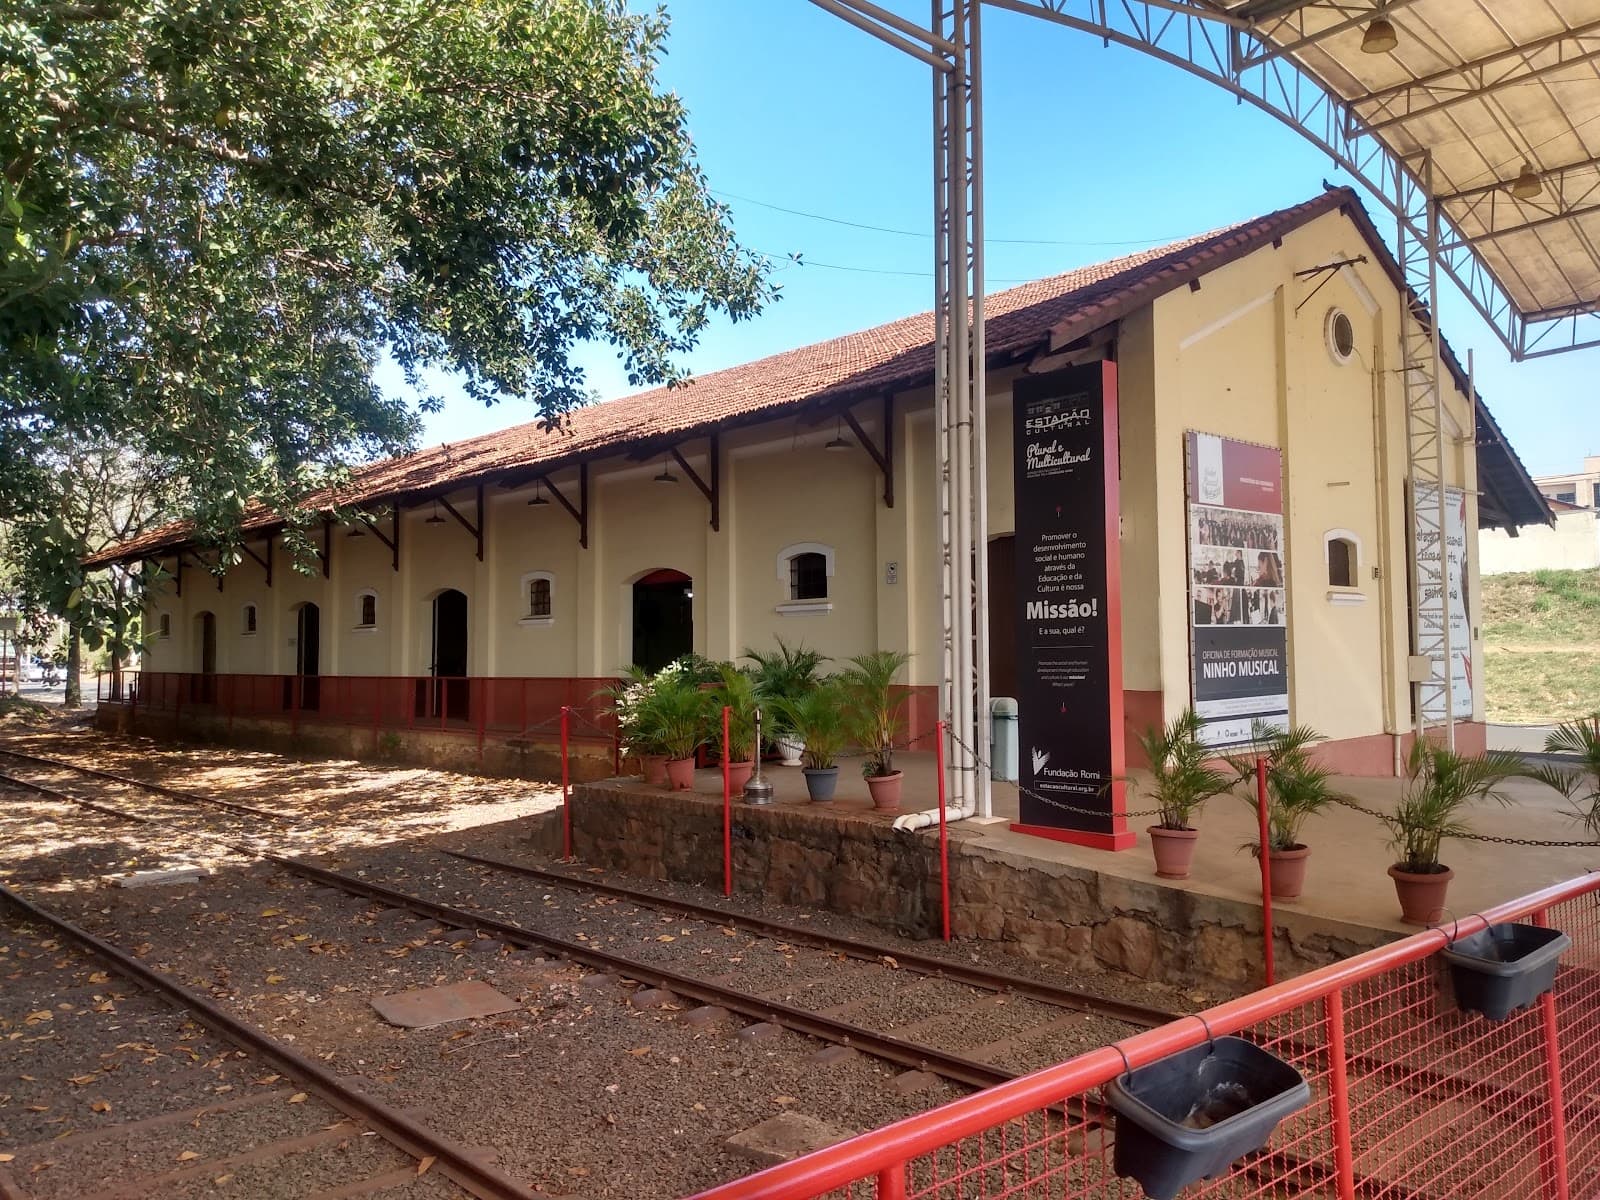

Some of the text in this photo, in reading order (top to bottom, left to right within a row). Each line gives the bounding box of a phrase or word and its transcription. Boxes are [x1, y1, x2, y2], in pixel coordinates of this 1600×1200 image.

[1026, 420, 1090, 435] CULTURAL
[1026, 440, 1064, 458] Plural e
[1026, 448, 1091, 470] Multicultural
[1042, 533, 1071, 541] Promover
[1033, 542, 1086, 552] desenvolvimento
[1034, 554, 1052, 562] social
[1044, 564, 1066, 572] através
[1038, 574, 1068, 582] Educação
[1037, 584, 1059, 592] Cultura
[1026, 598, 1098, 620] Missão!
[1062, 626, 1076, 635] qual
[1202, 648, 1279, 659] OFICINA DE FORMAÇÃO MUSICAL
[1204, 660, 1279, 679] NINHO MUSICAL
[1044, 768, 1100, 779] Fundação Romi
